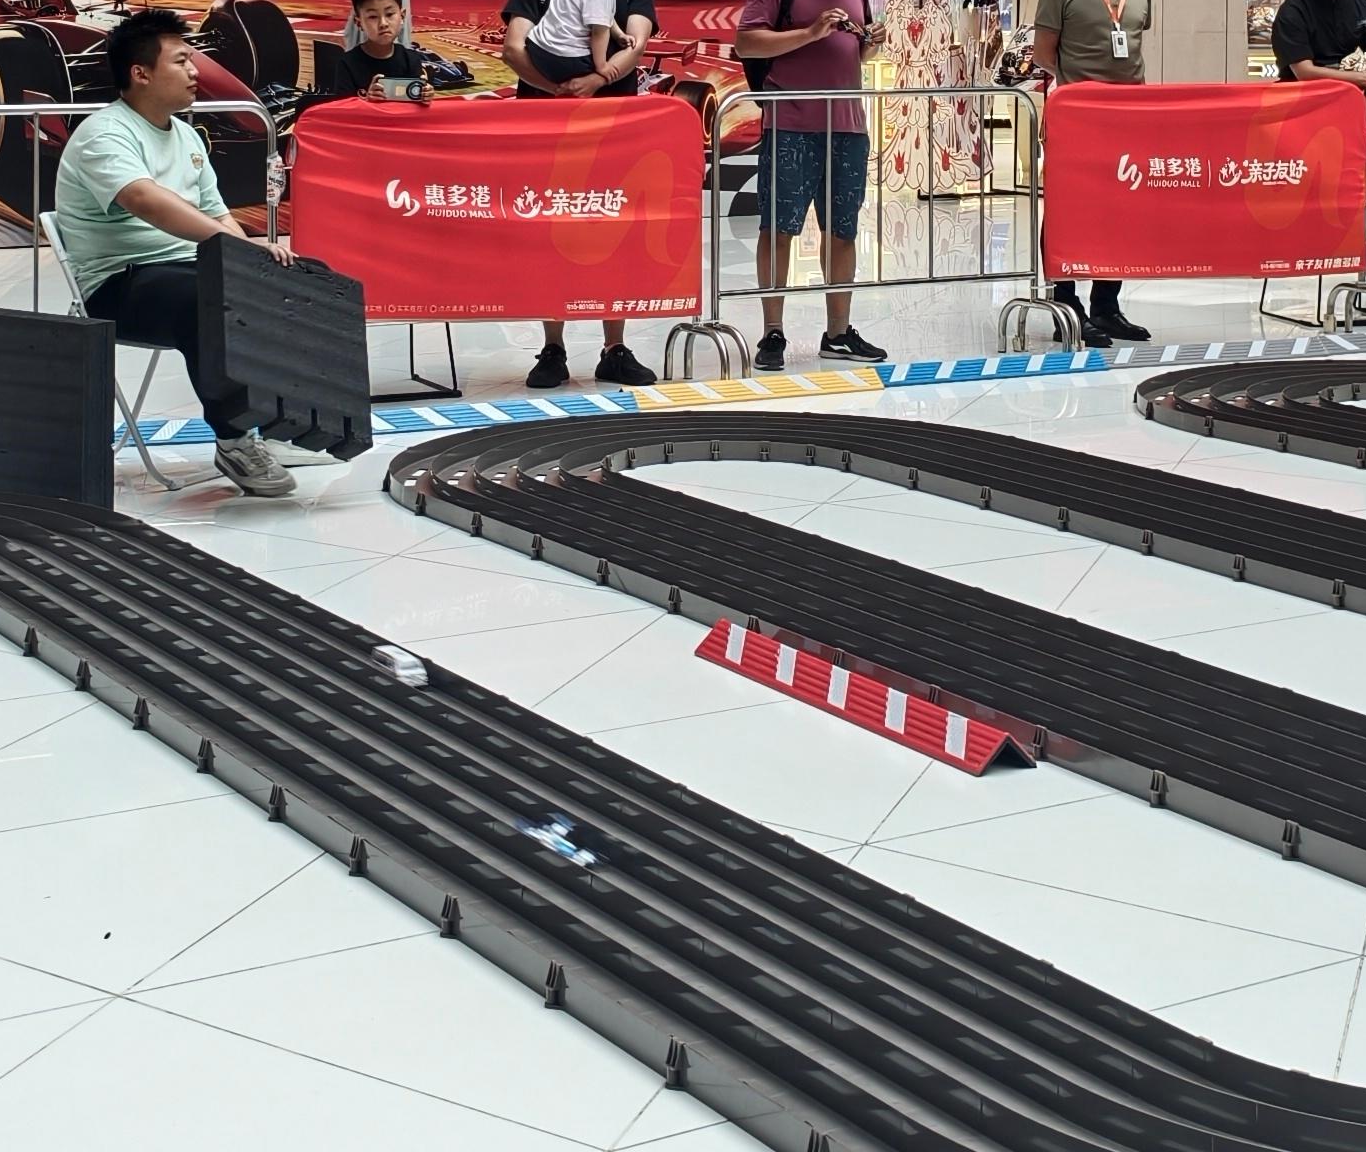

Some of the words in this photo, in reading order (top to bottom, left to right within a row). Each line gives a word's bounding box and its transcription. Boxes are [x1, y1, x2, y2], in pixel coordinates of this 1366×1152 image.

[1148, 157, 1202, 177] 惠多港
[1241, 159, 1308, 185] 亲子友好
[1147, 179, 1179, 188] HUIDUO
[424, 183, 491, 208] 惠多港
[541, 188, 629, 218] 亲子友好
[426, 208, 468, 218] HUIDUO
[469, 209, 496, 219] MALL
